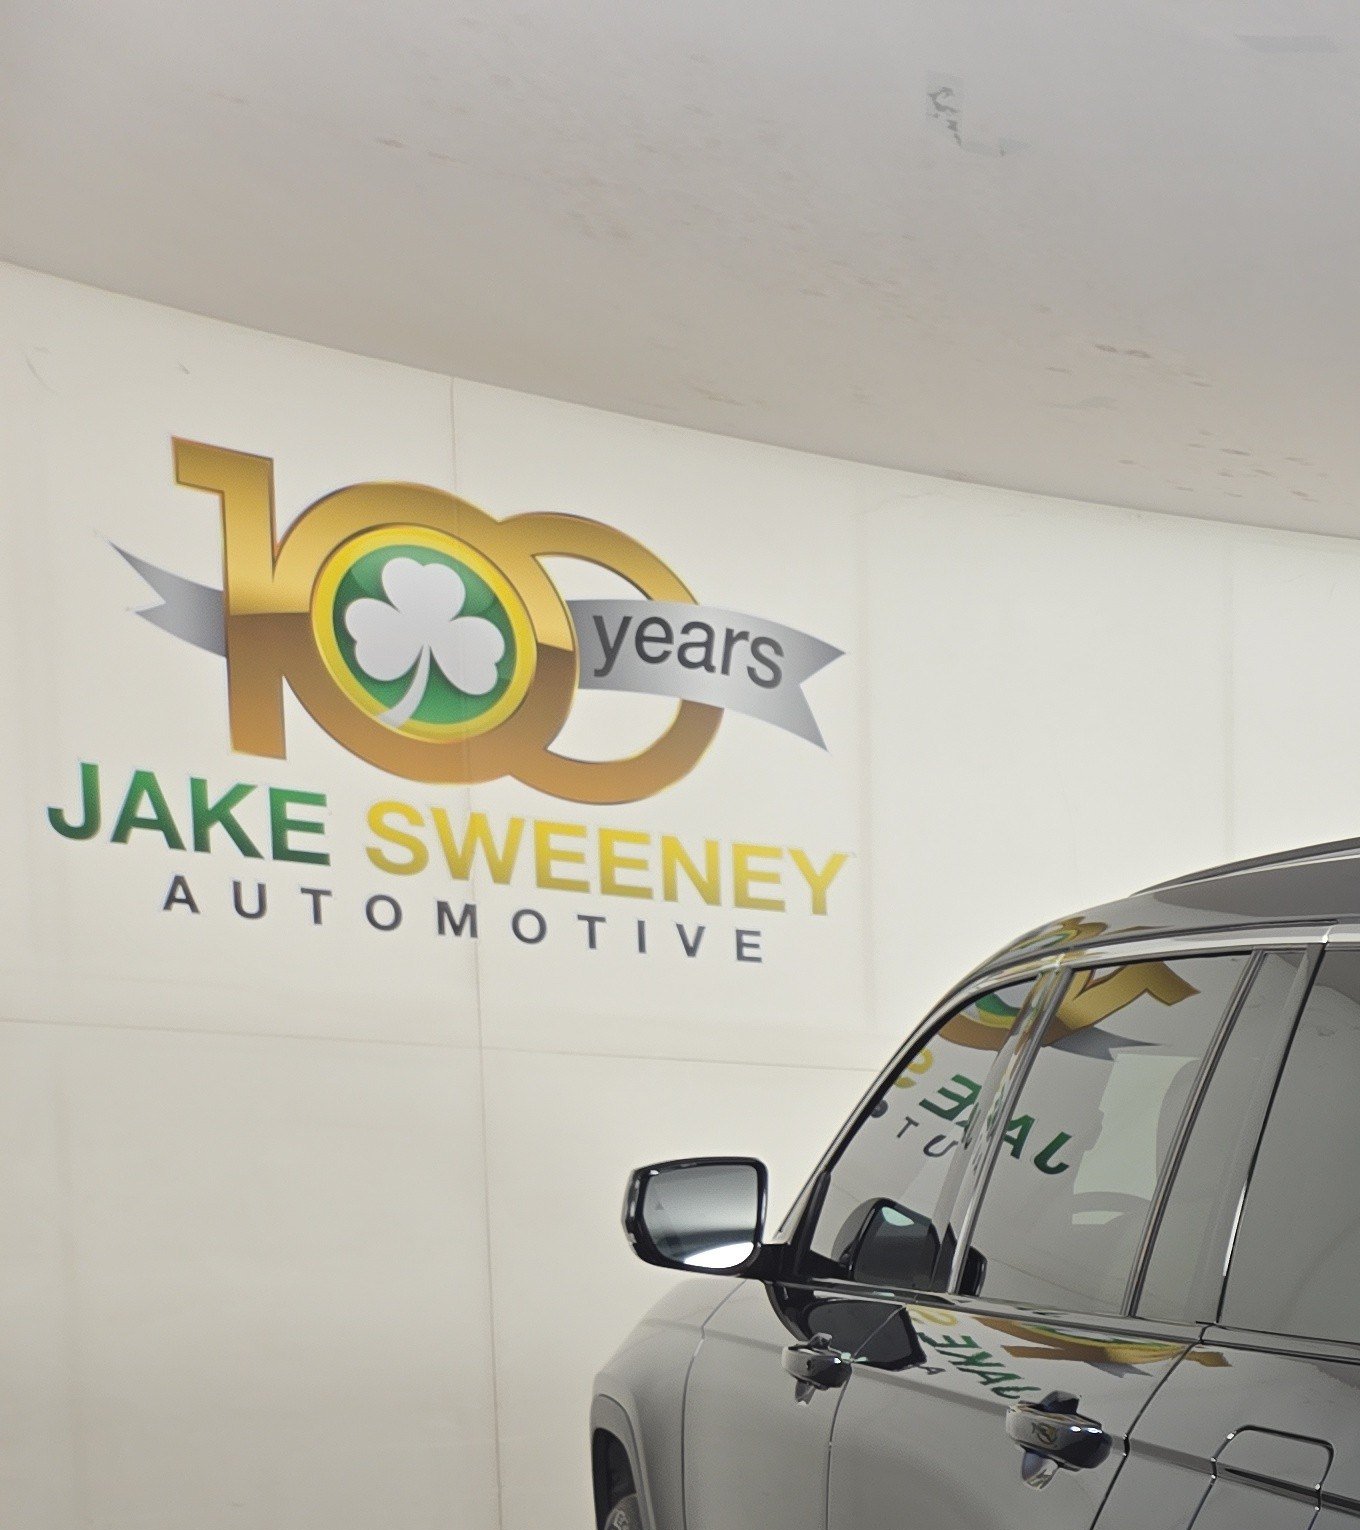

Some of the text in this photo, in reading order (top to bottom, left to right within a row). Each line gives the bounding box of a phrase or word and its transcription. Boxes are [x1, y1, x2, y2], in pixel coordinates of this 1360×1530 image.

[593, 613, 785, 689] years
[47, 762, 848, 916] JAKE SWEENEY
[163, 874, 763, 963] AUTOMOTIVE
